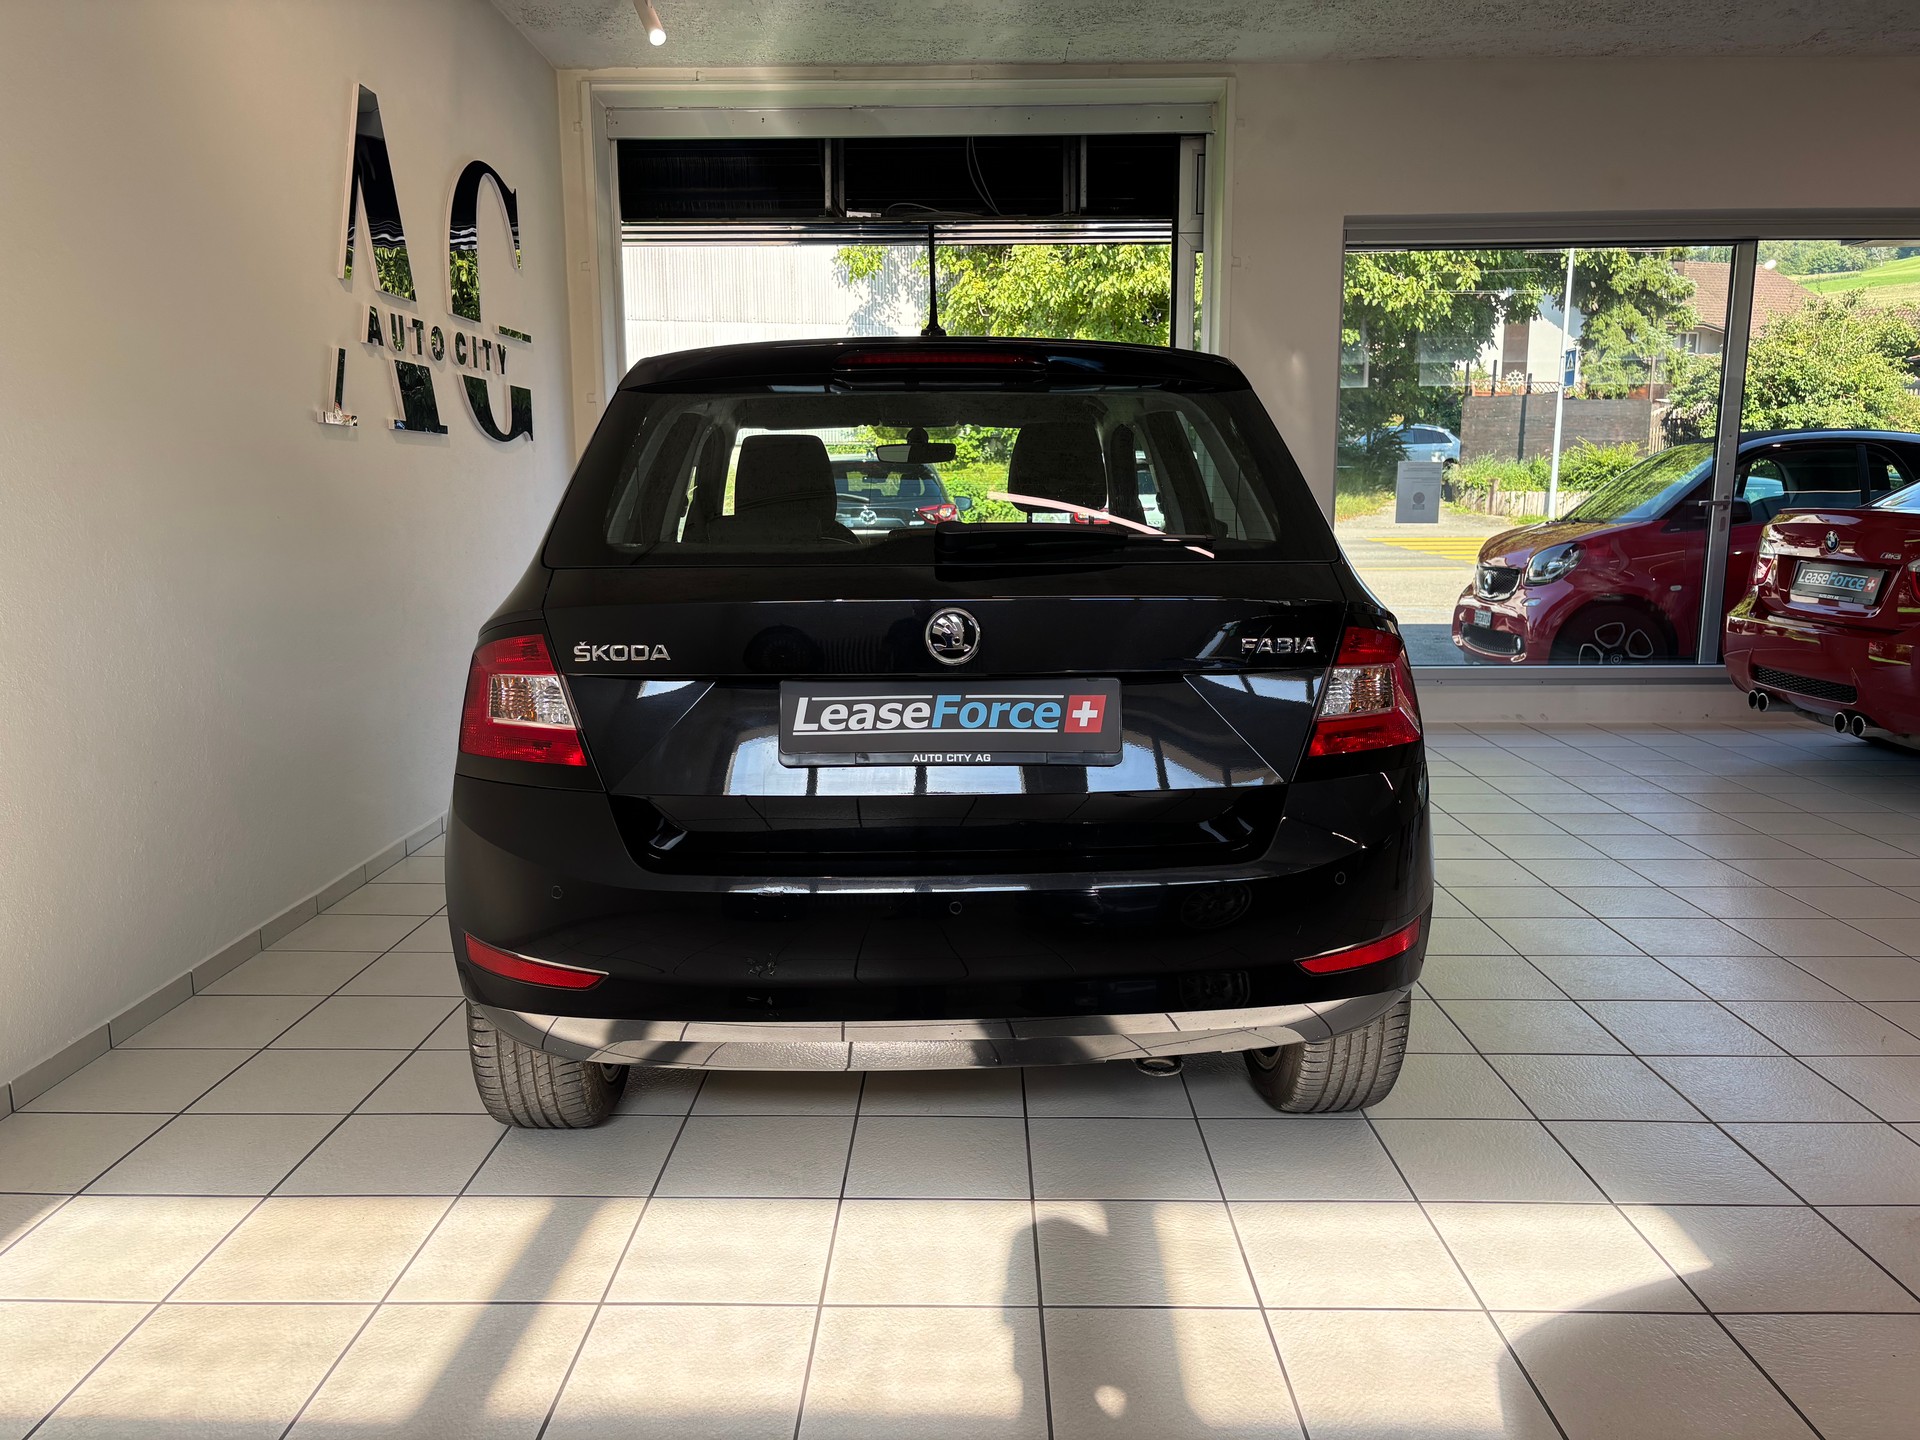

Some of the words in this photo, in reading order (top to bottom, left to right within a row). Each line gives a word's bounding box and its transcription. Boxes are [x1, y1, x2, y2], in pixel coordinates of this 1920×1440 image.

[1798, 569, 1866, 590] LeaseForce
[573, 641, 671, 662] ŠKODA
[1241, 636, 1319, 655] FABIA
[793, 694, 1062, 731] LeaseForce
[912, 753, 943, 763] AUTO
[946, 753, 972, 763] CITY
[975, 753, 992, 763] AG
